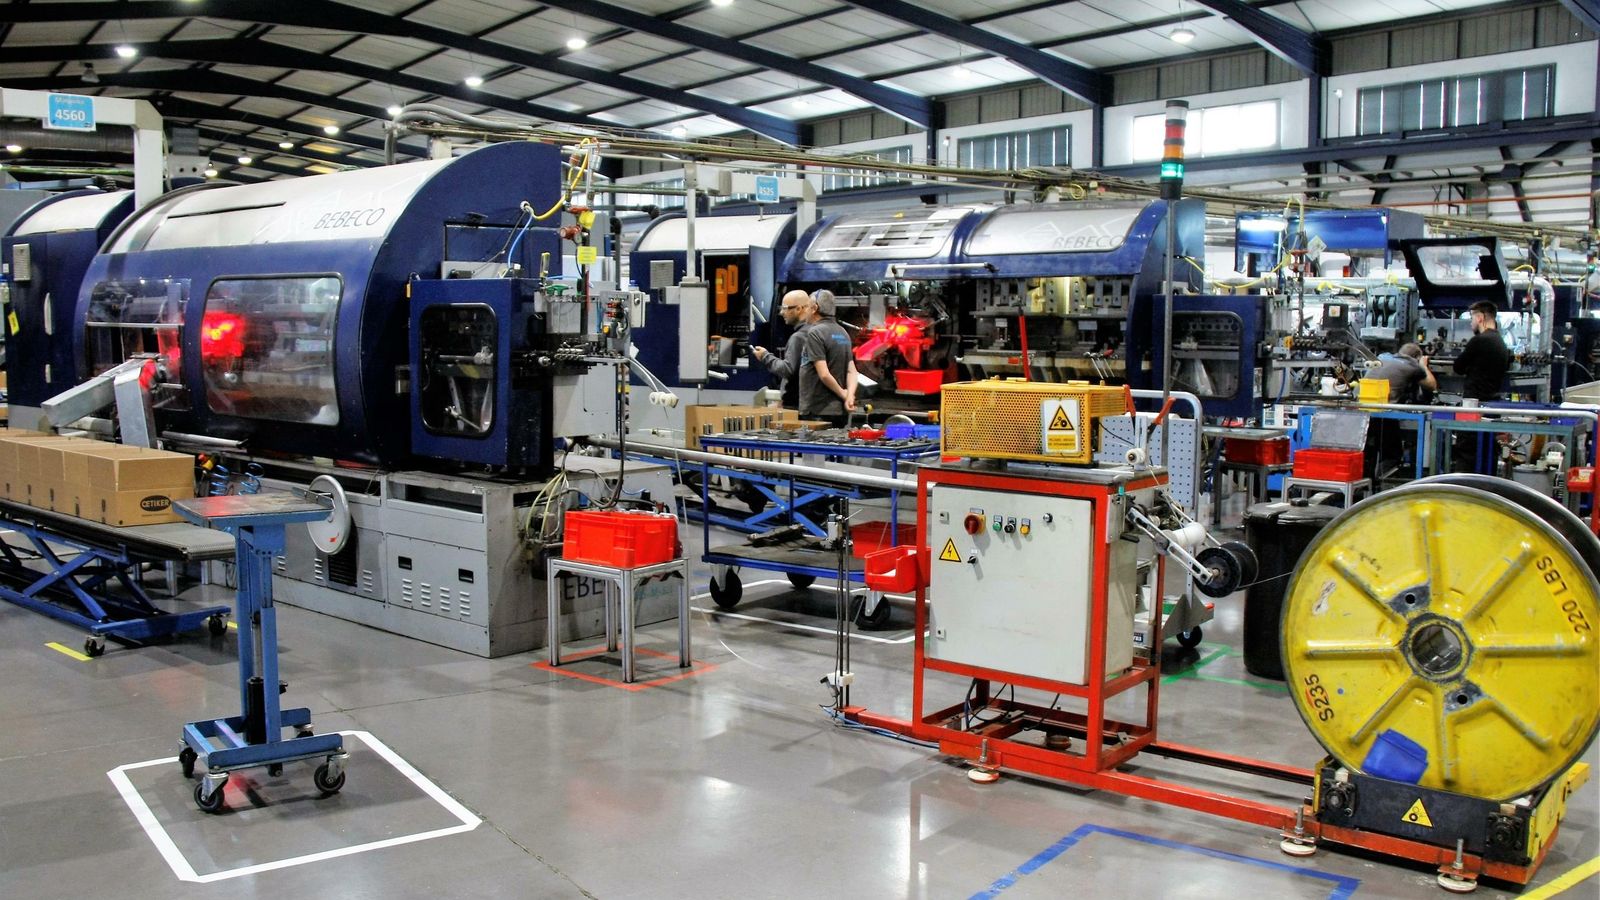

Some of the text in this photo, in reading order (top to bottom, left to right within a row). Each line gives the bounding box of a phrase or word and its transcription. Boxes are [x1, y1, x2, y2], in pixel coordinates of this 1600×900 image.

[55, 109, 86, 121] 4560
[313, 207, 386, 230] BEBECO
[562, 576, 606, 600] EBE
[1537, 556, 1591, 633] 220 LBS
[1304, 674, 1334, 722] S235
